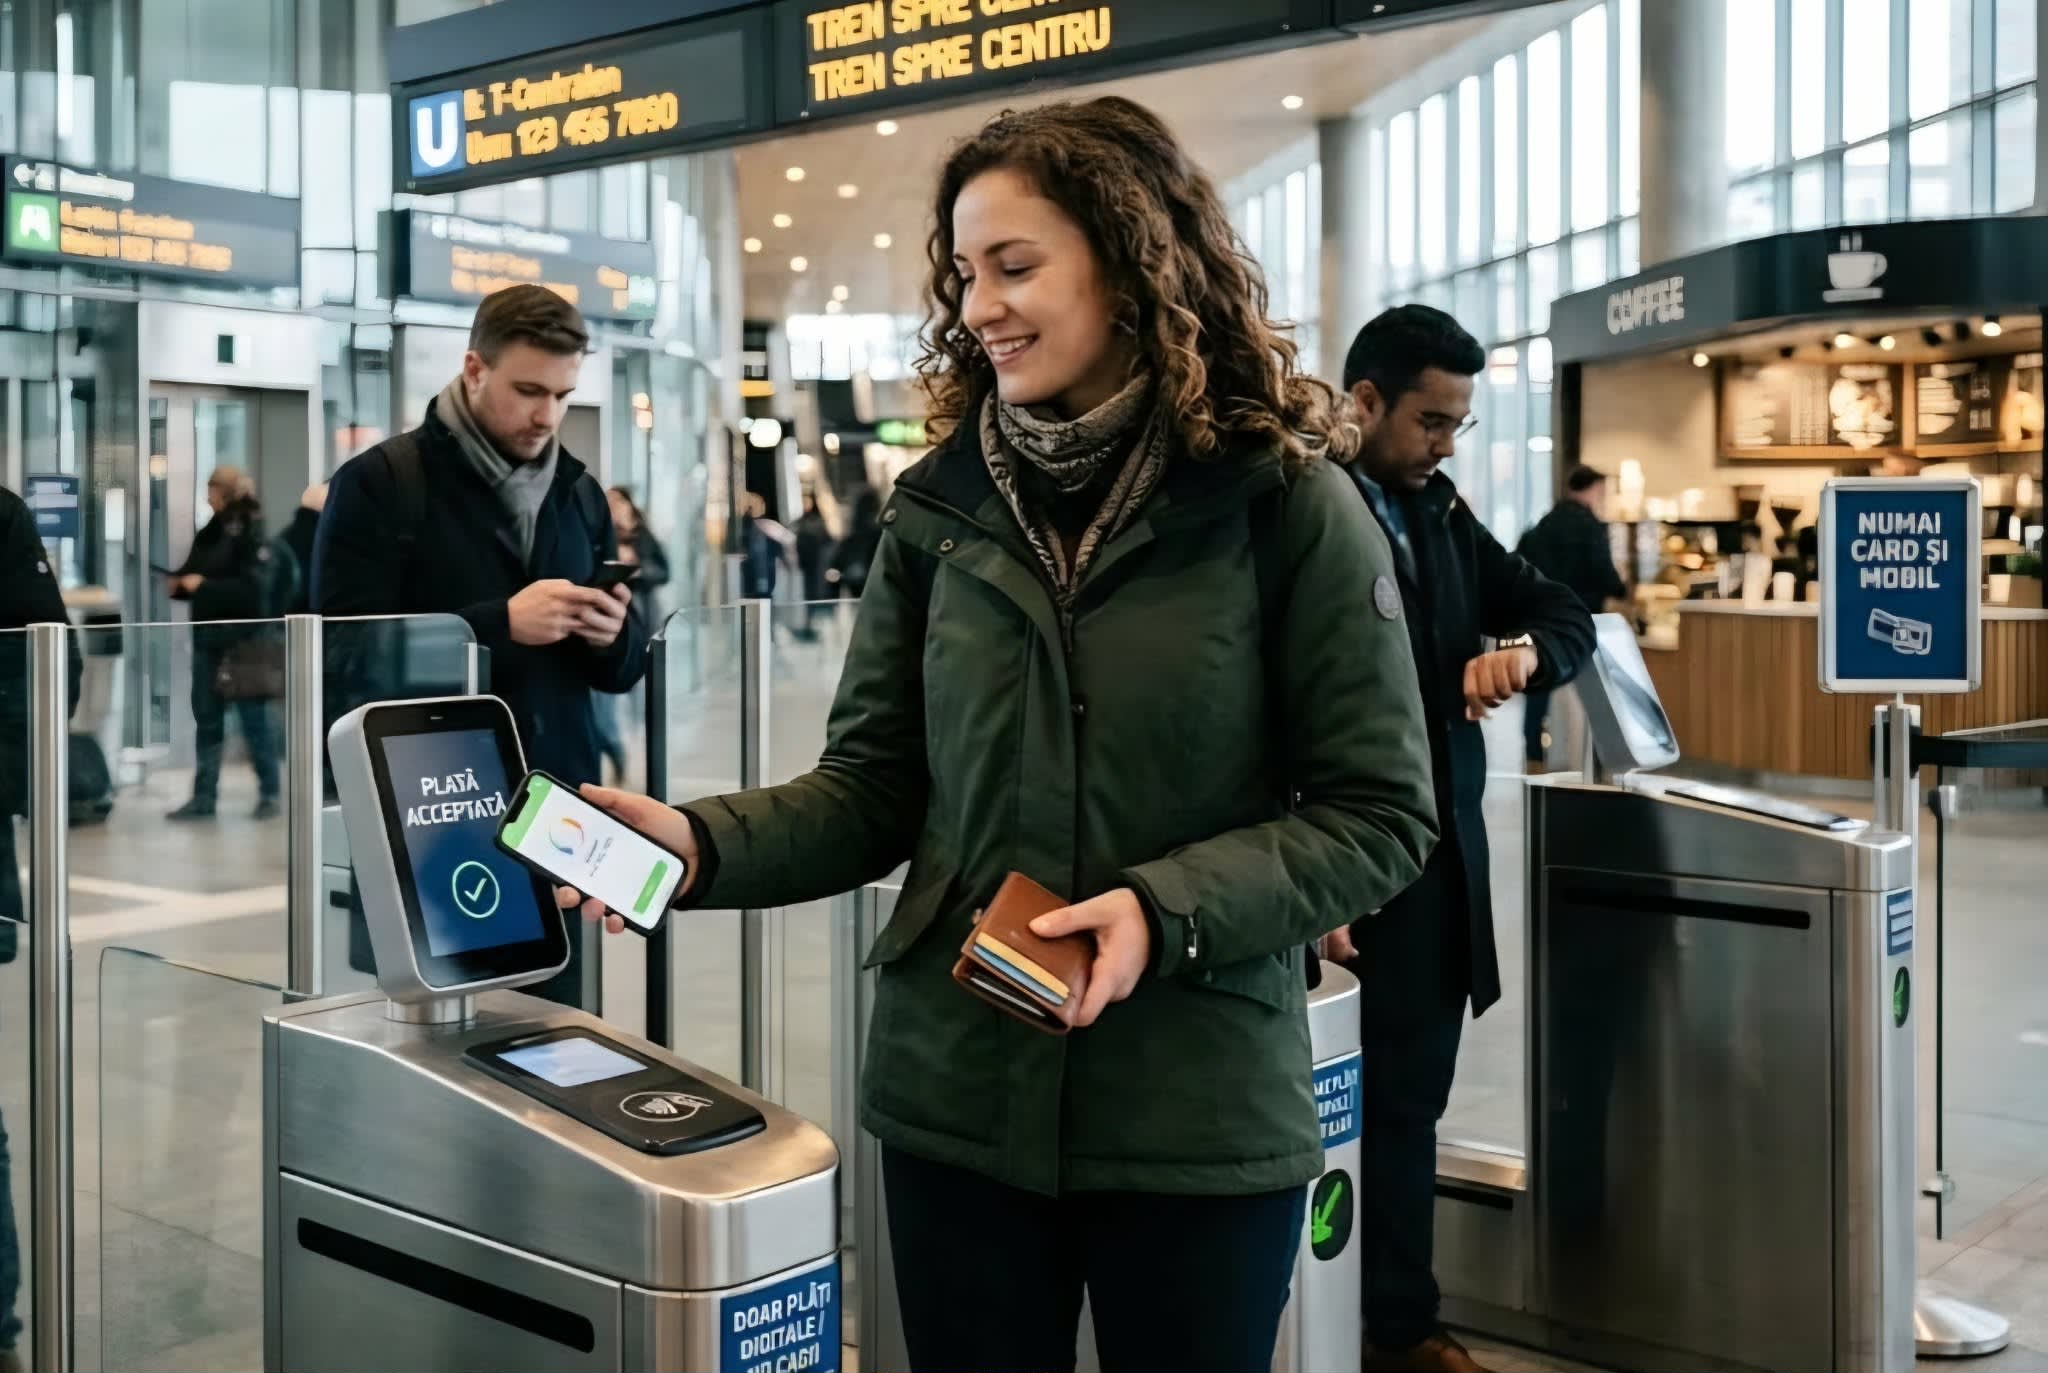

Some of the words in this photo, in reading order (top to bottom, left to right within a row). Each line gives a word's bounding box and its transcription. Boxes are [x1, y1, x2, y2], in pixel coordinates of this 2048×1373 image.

[808, 0, 885, 51] TREN
[808, 52, 886, 102] TREN
[892, 35, 973, 86] SPRE
[981, 7, 1110, 70] CENTRU
[417, 102, 458, 168] U
[1858, 512, 1940, 535] NUMAI
[1851, 539, 1920, 562] CARD
[1860, 566, 1941, 589] MOBIL
[733, 1299, 783, 1333] DOAR
